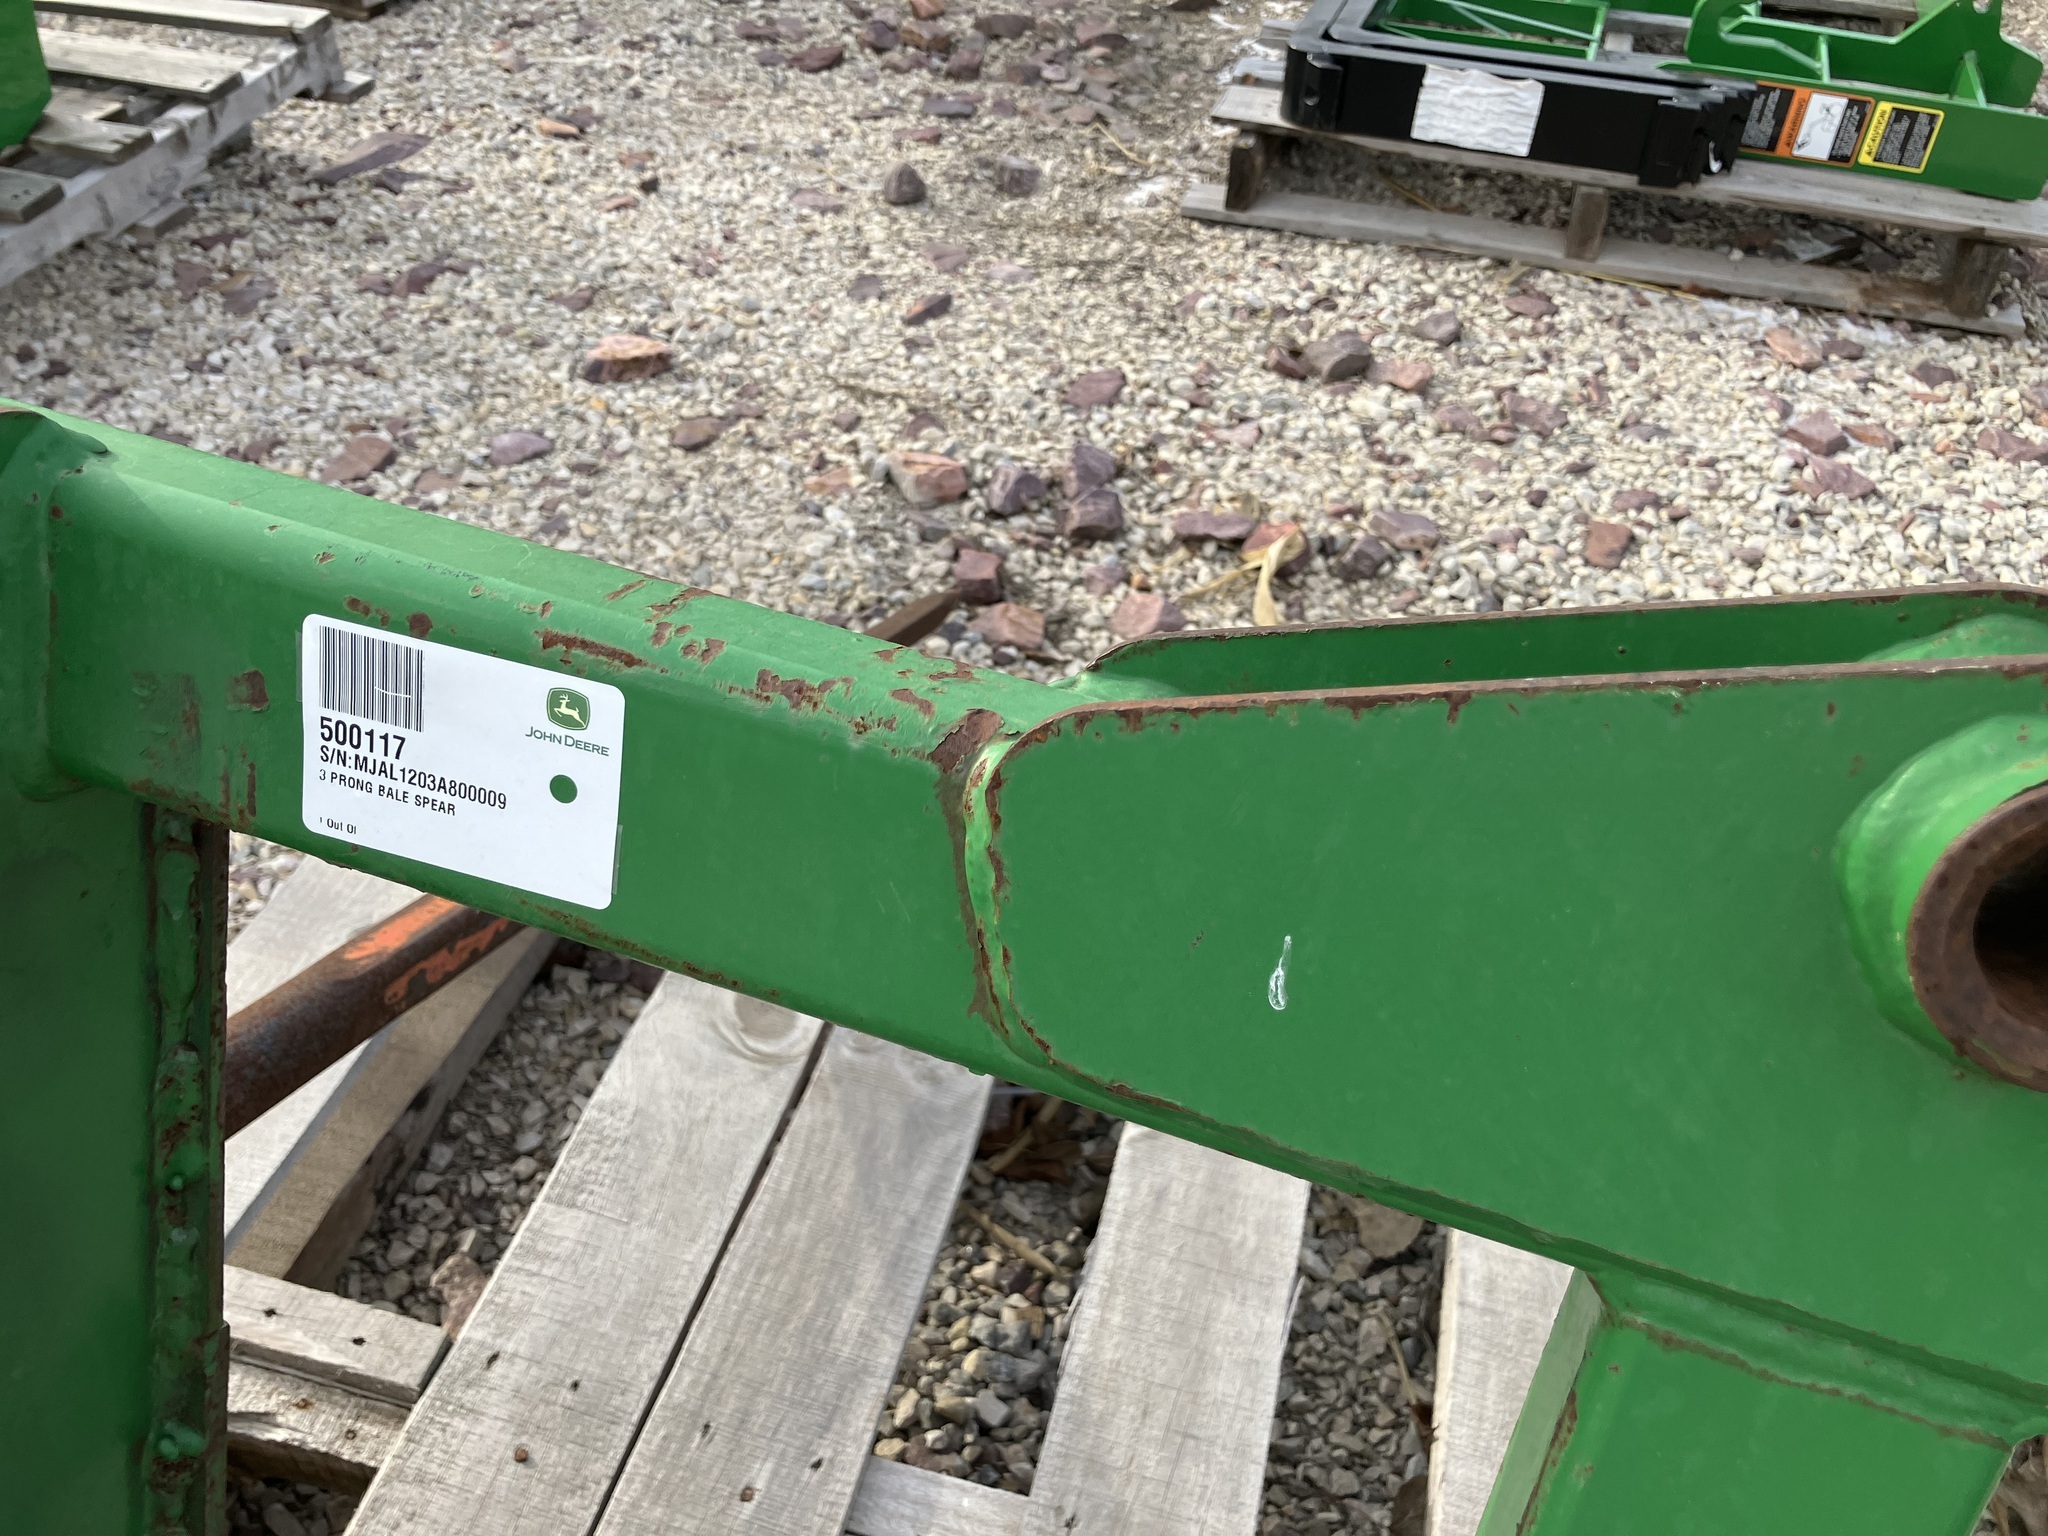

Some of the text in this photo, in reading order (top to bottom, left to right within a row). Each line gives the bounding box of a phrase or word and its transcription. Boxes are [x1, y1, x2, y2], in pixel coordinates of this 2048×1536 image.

[320, 716, 406, 760] 500117
[525, 726, 610, 756] JOHN DEERE
[319, 769, 456, 816] 3 PRONG BALE SPEAR
[320, 745, 507, 810] S/N:MJAL1203A800009
